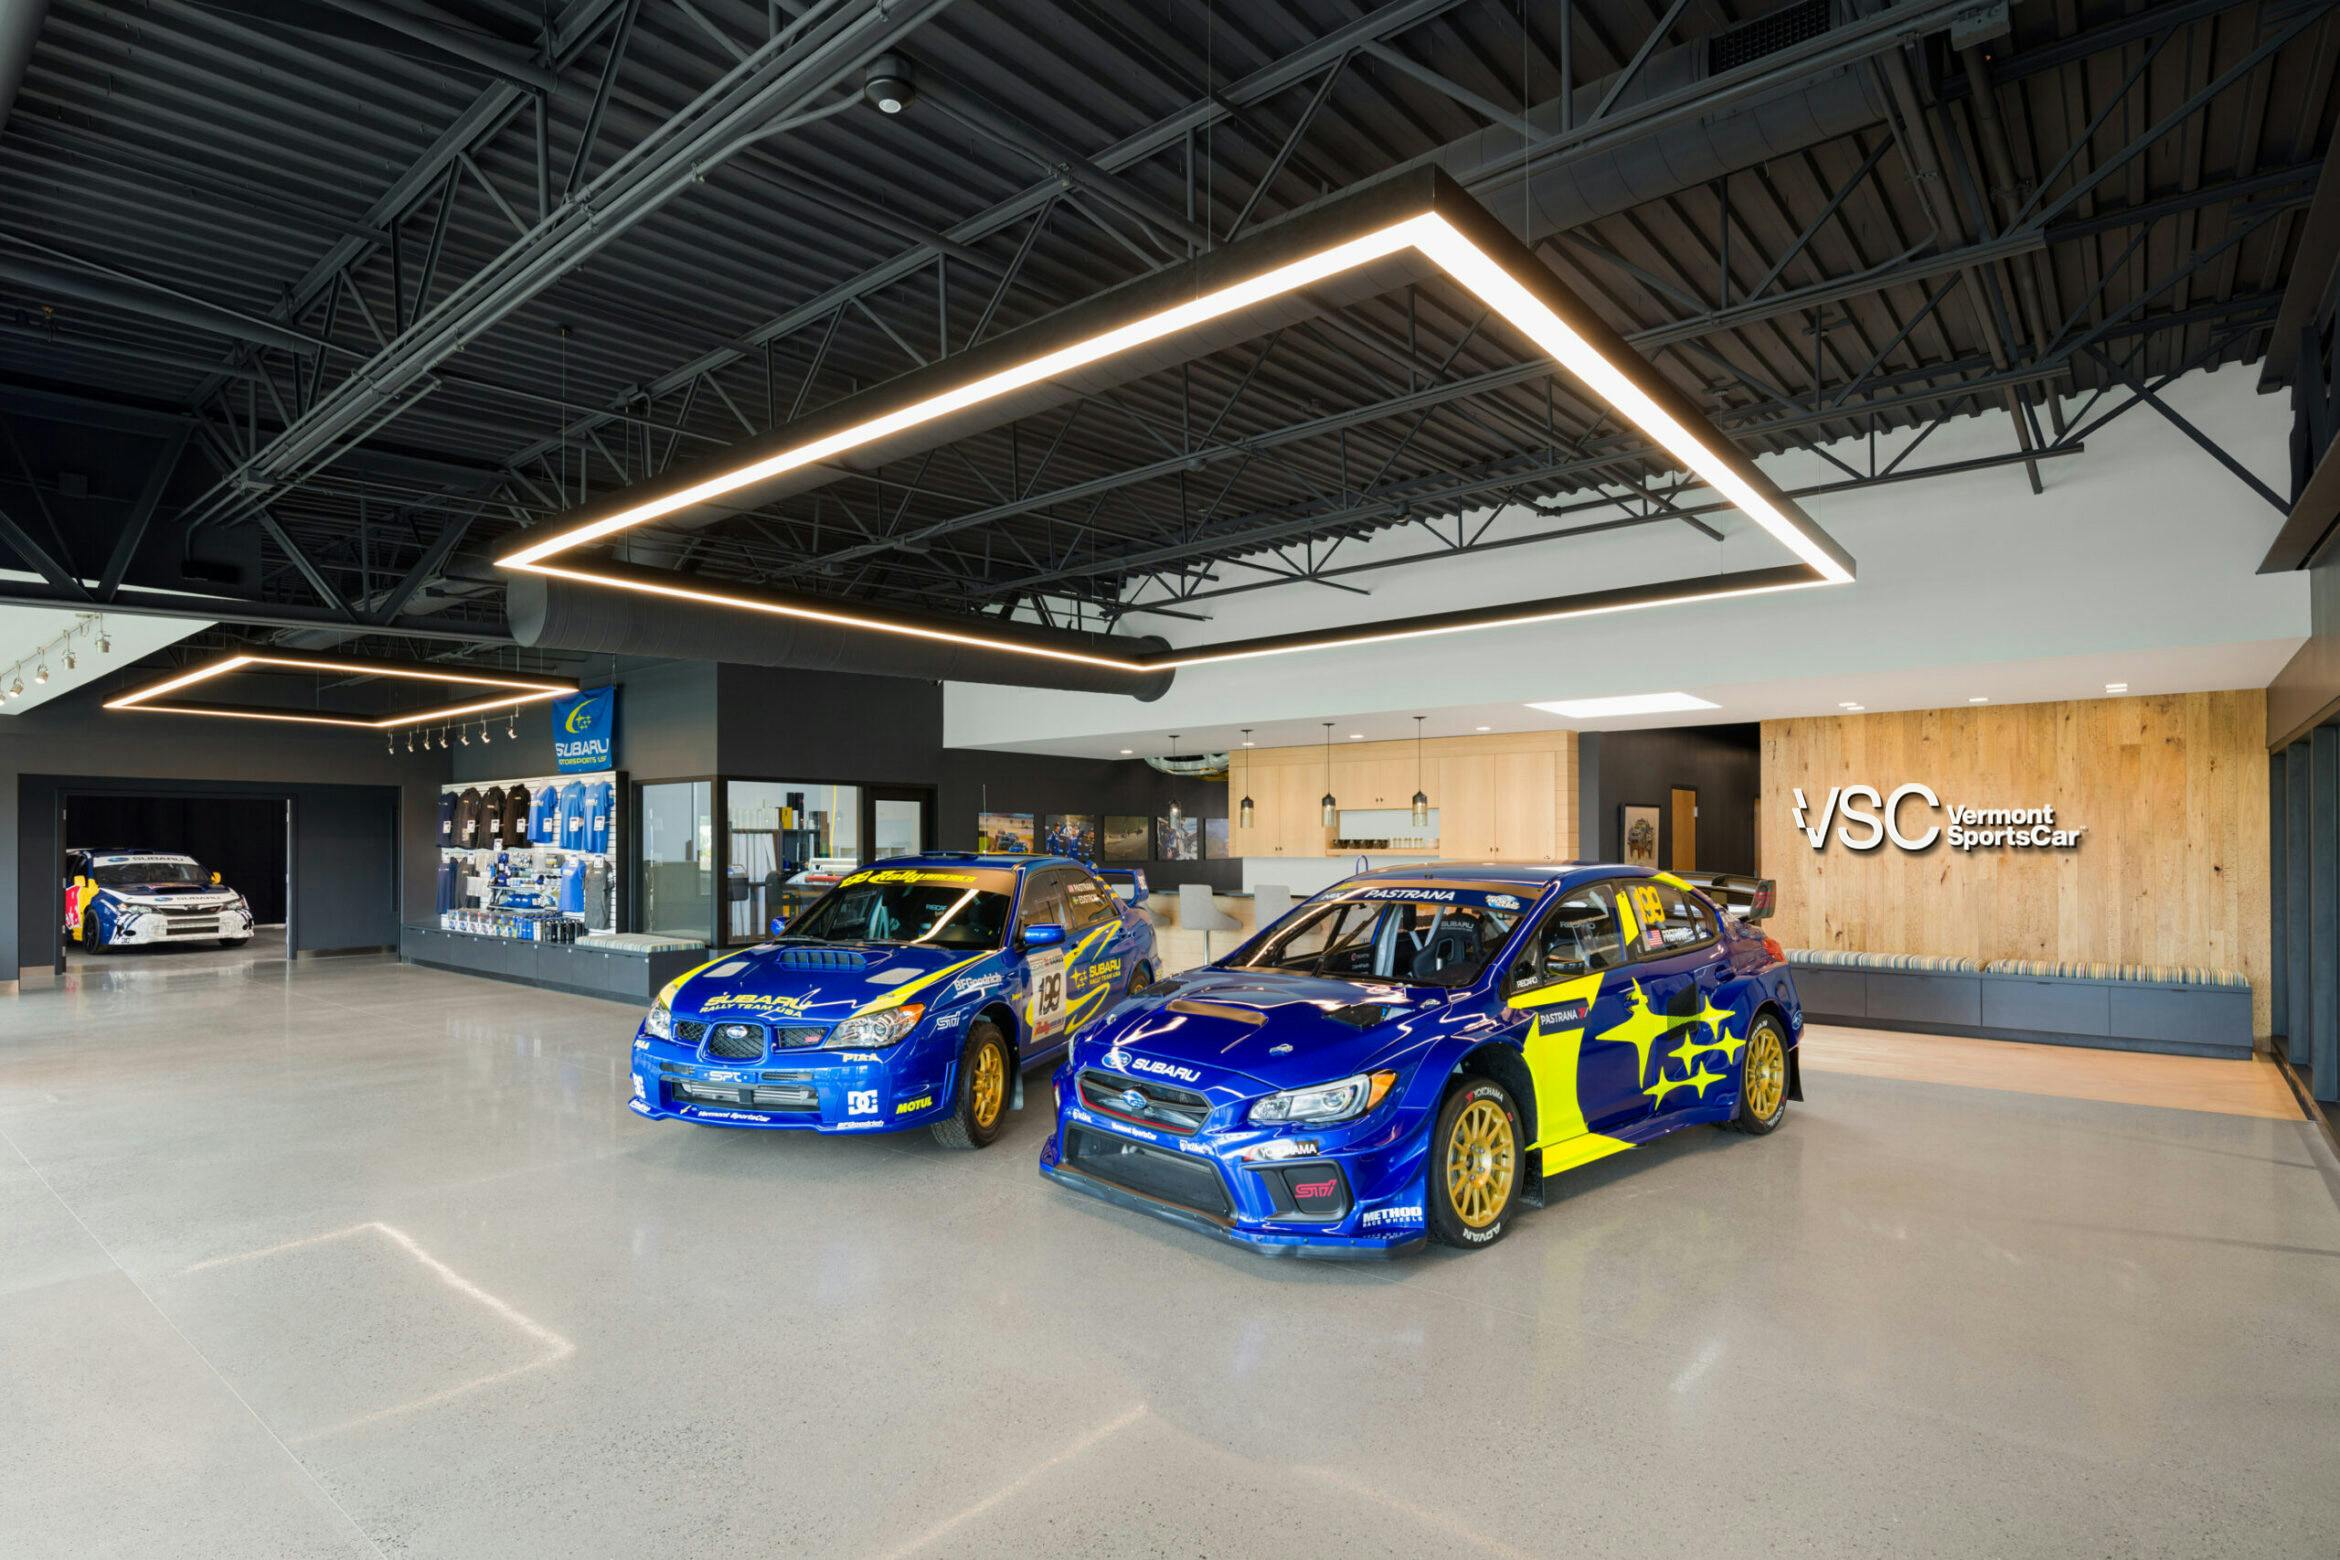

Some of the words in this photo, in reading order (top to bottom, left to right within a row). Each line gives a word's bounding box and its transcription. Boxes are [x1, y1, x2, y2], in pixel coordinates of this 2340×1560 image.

[555, 738, 610, 757] SUBARU
[1791, 783, 1940, 850] VSC
[1946, 804, 2054, 826] Vermont
[1946, 825, 2081, 851] SportsCar
[1364, 889, 1456, 901] PASTRANA
[1089, 958, 1121, 978] SUBARU
[703, 994, 814, 1011] SUBARU
[1038, 972, 1061, 1017] 199
[699, 1004, 735, 1014] RALLY
[736, 1003, 774, 1012] TEAM
[775, 1008, 803, 1019] USA
[1540, 1010, 1578, 1026] PASTRANA
[842, 1053, 880, 1063] PIAA
[1131, 1058, 1202, 1083] SUBARU
[847, 1089, 879, 1115] DC
[1473, 1086, 1504, 1103] YOKOHAMA
[895, 1096, 933, 1115] MOTUL
[1259, 1144, 1318, 1158] YOHAMA
[1363, 1206, 1423, 1223] METHOD
[1462, 1222, 1501, 1243] ADVAN
